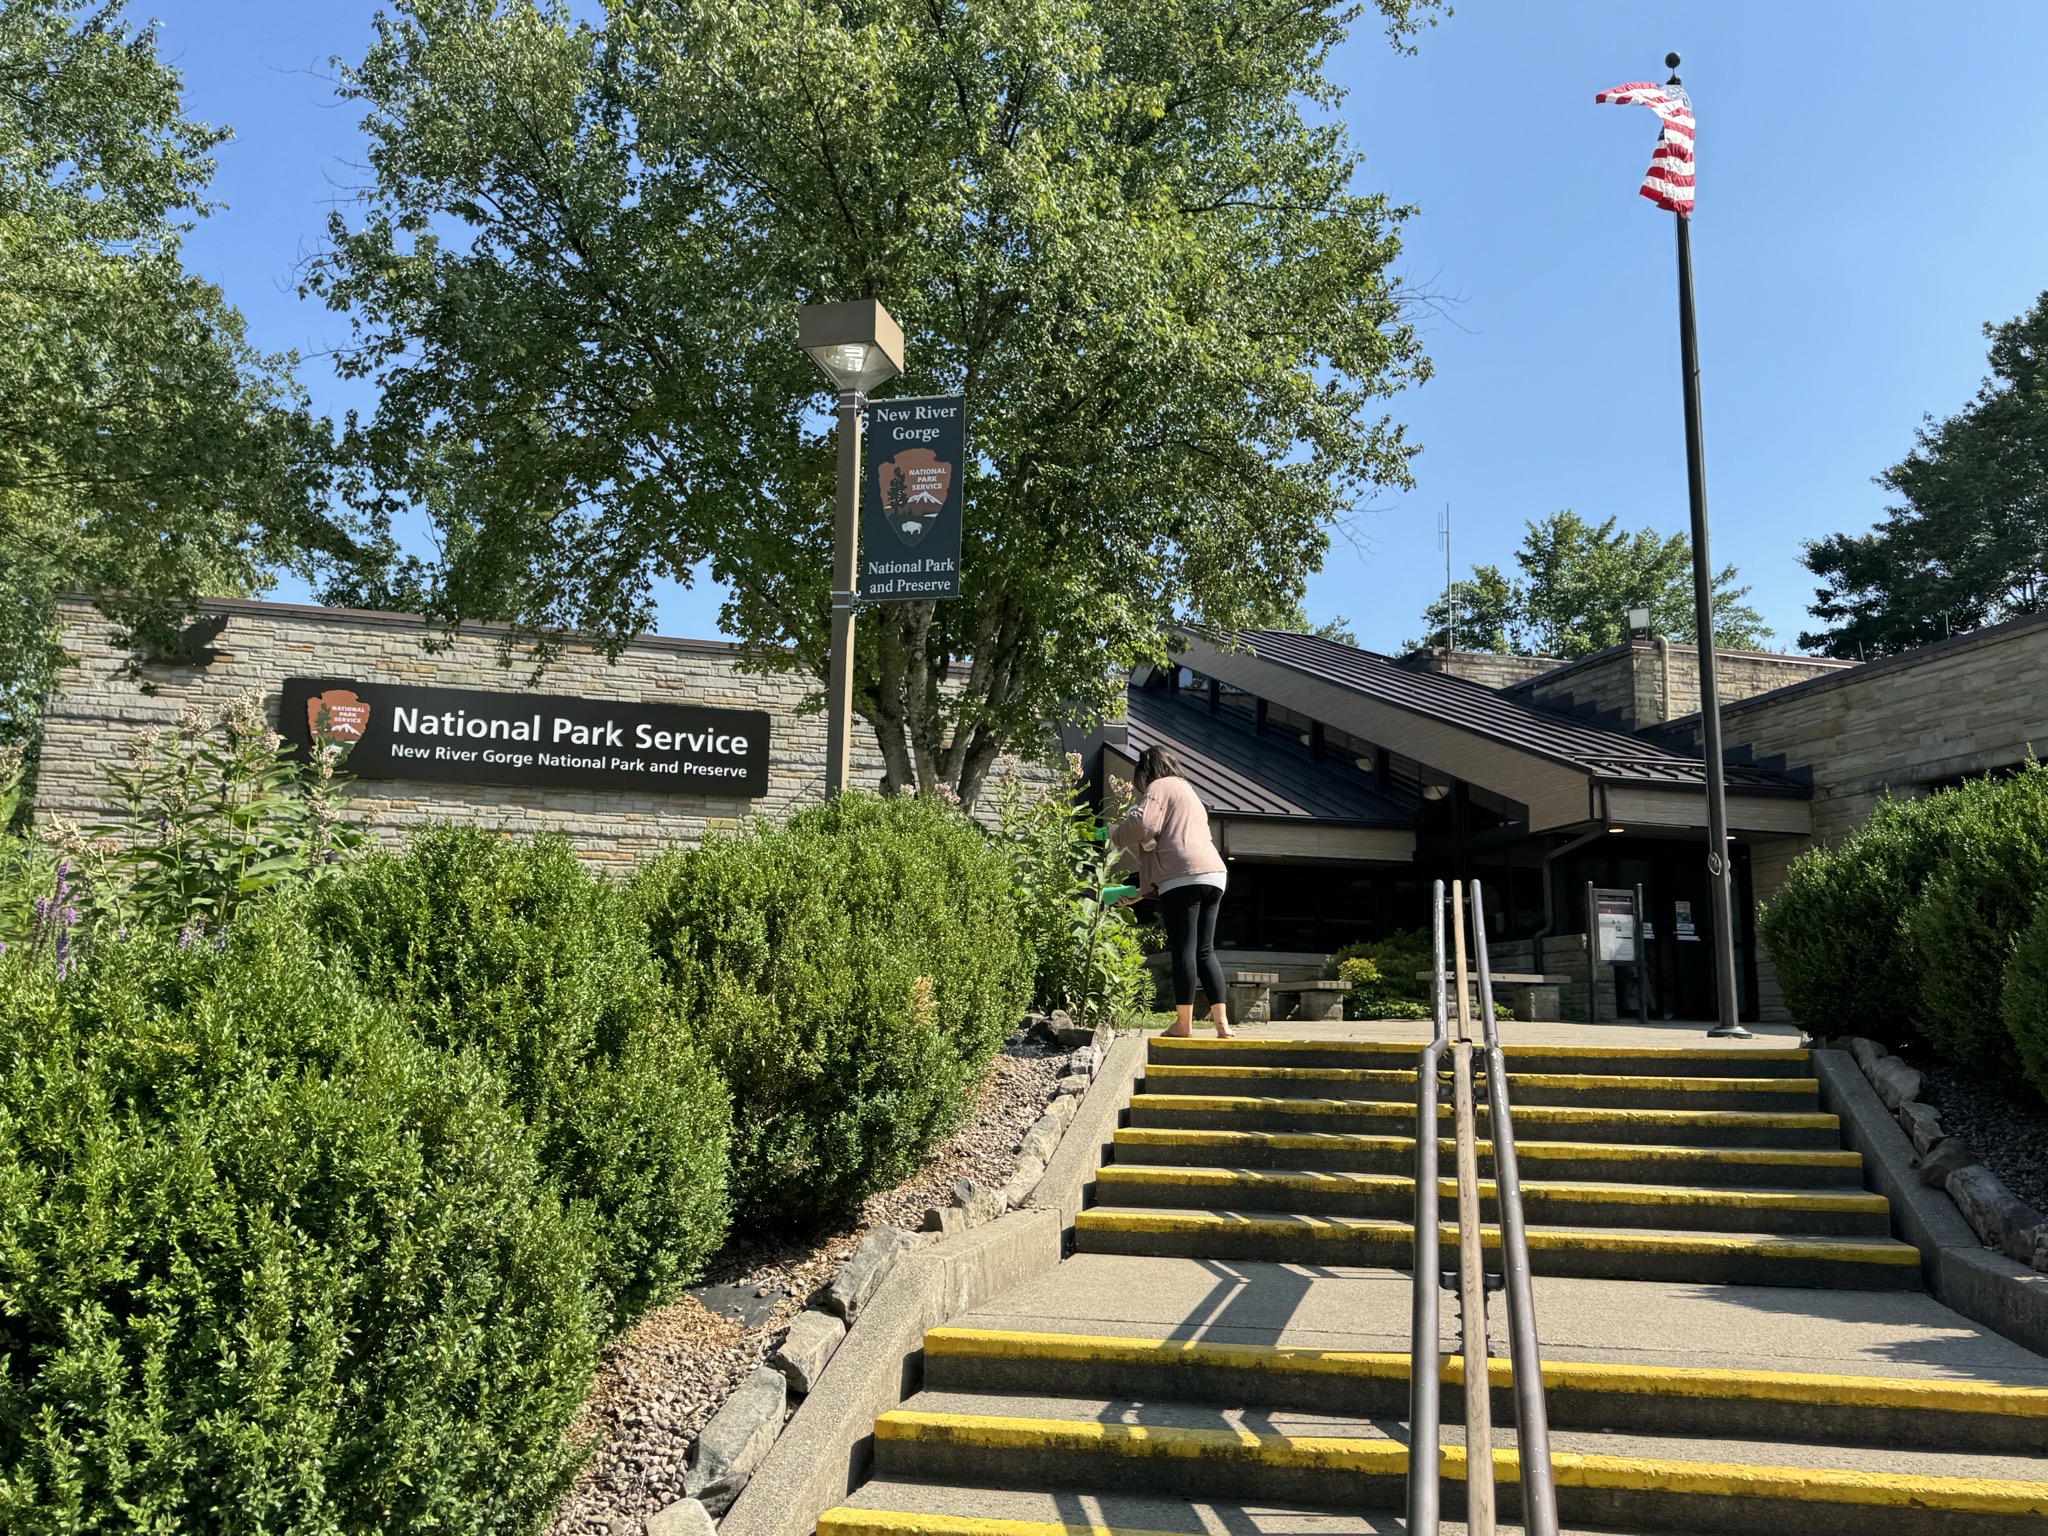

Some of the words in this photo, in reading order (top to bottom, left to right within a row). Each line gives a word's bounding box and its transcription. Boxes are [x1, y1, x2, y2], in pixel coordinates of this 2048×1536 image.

[876, 408, 911, 422] New
[915, 406, 957, 420] River
[892, 426, 940, 442] Gorge
[868, 559, 922, 575] National
[925, 558, 955, 572] Park
[869, 579, 894, 594] and
[897, 579, 951, 592] Preserve
[332, 706, 365, 714] NATIONAL
[393, 706, 540, 742] National
[553, 717, 623, 748] Park
[635, 723, 749, 755] Service
[391, 743, 430, 759] New
[435, 746, 478, 762] River
[483, 749, 533, 767] Gorge
[538, 752, 606, 769] National
[611, 757, 645, 773] Park
[649, 759, 678, 775] and
[683, 762, 748, 778] Preserve
